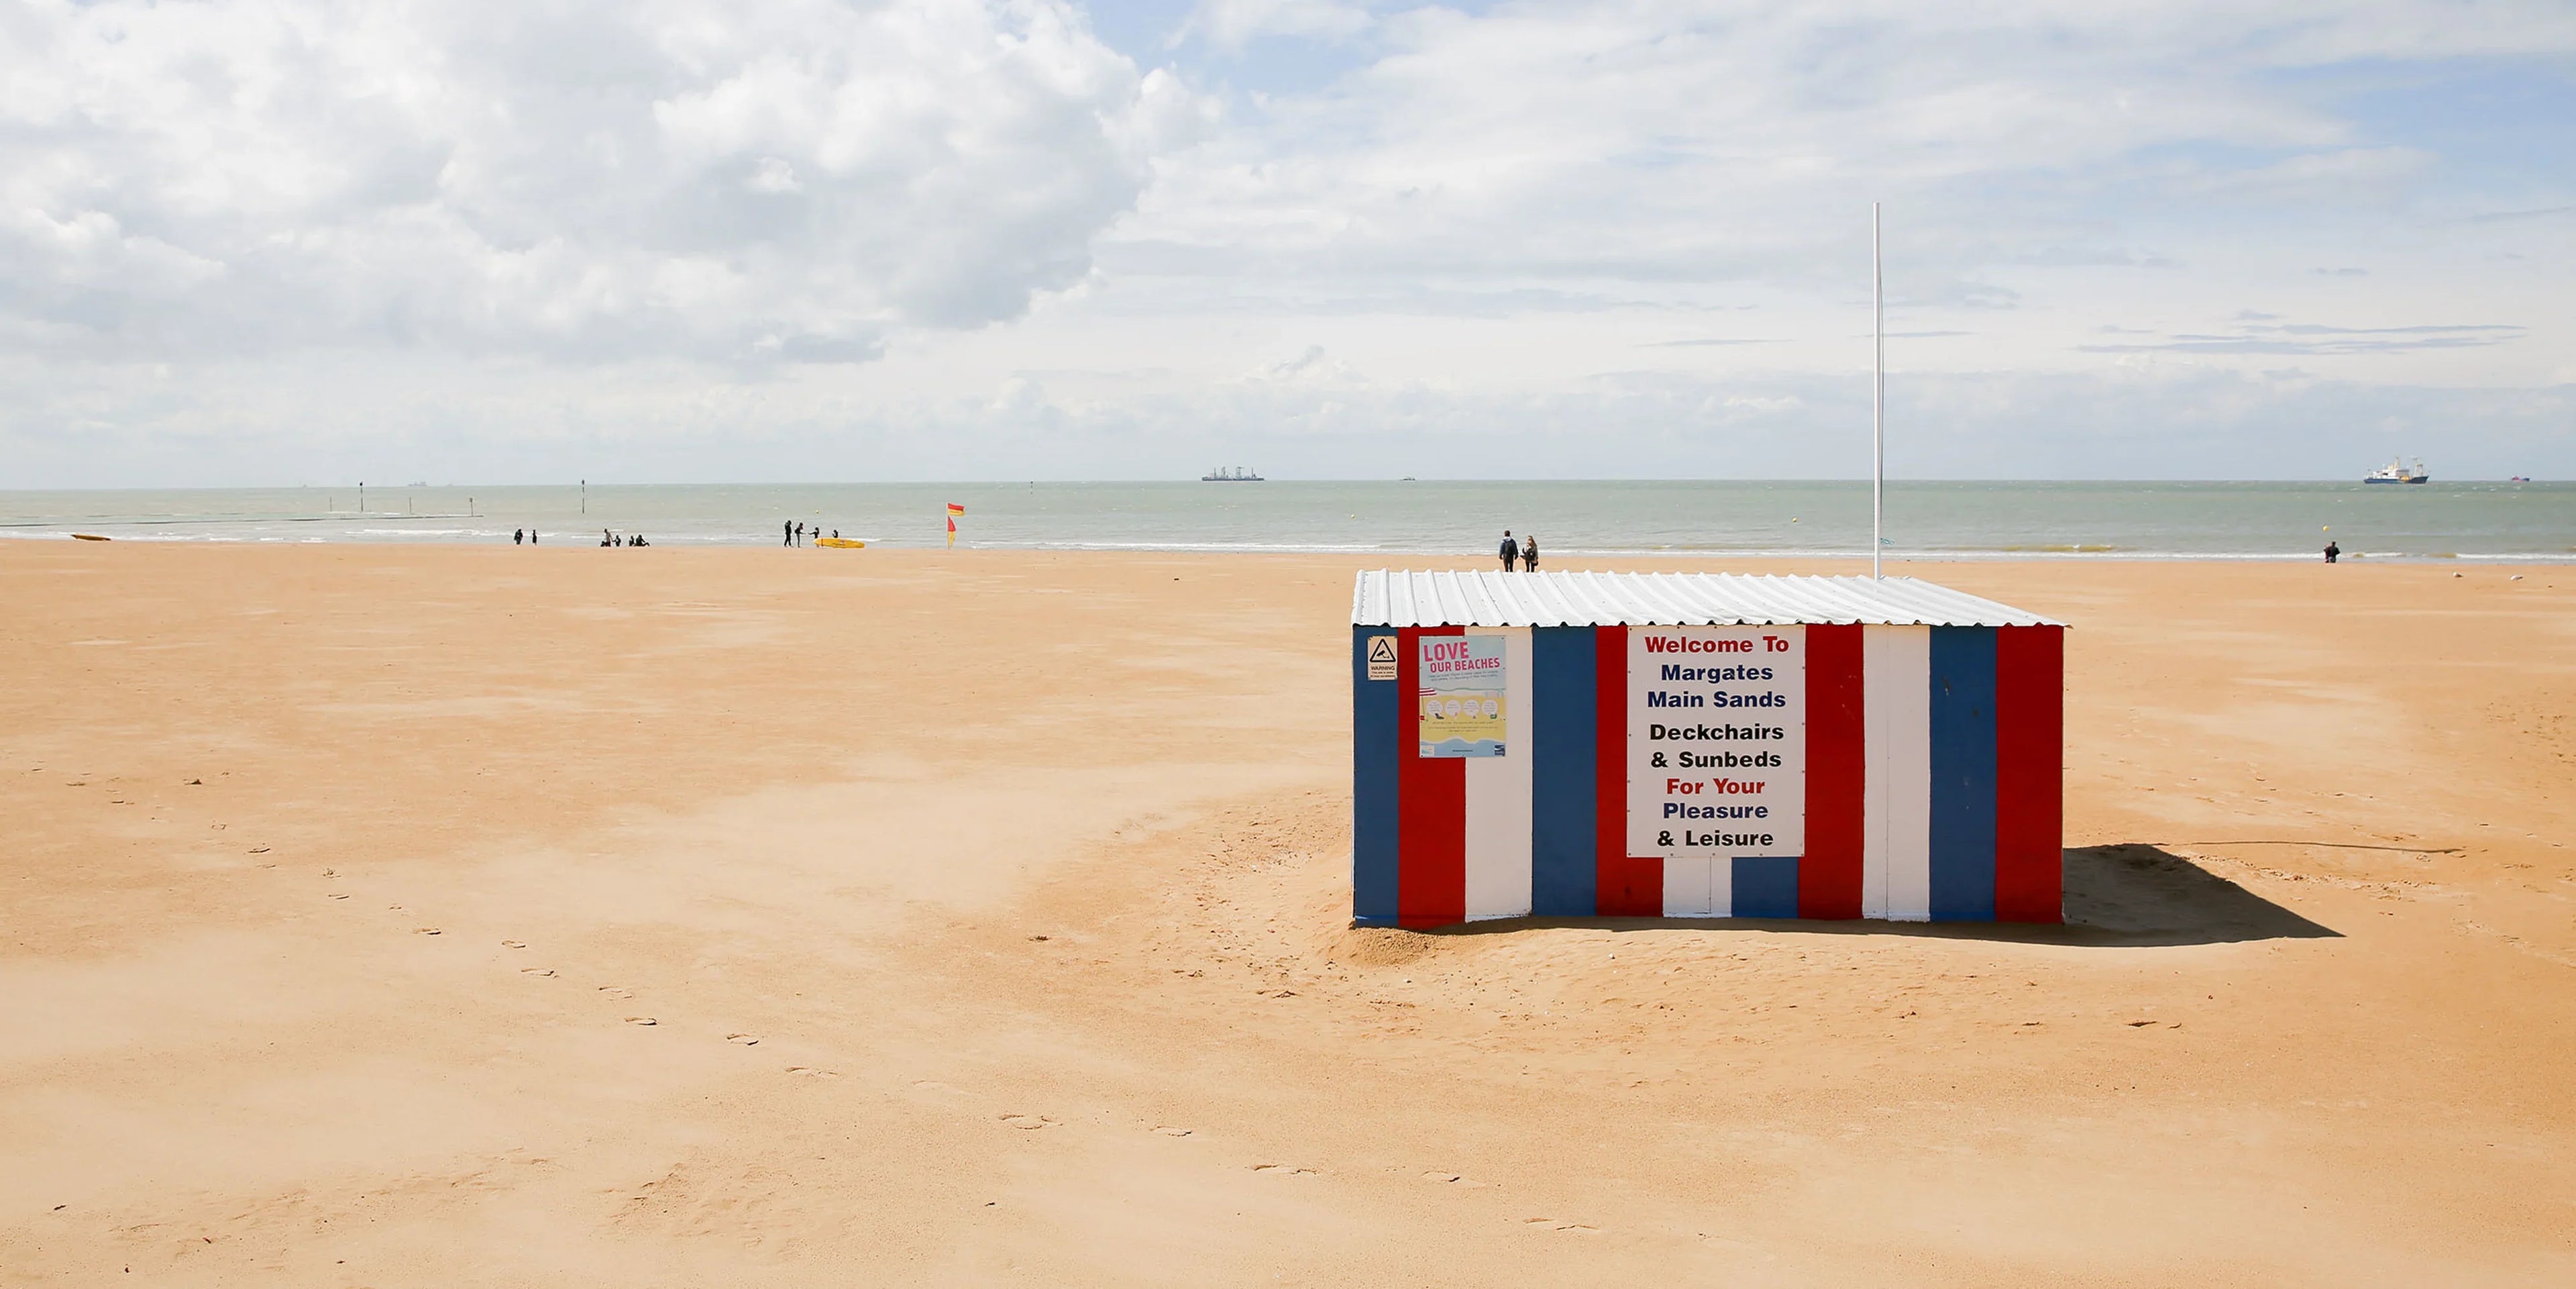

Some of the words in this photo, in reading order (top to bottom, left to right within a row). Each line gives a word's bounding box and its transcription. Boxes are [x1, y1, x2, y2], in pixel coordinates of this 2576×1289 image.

[1424, 641, 1469, 662] LOVE
[1645, 636, 1753, 653] Welcome
[1763, 635, 1789, 653] To
[1430, 662, 1452, 673] OUR
[1454, 658, 1501, 671] BEACHES
[1661, 664, 1773, 684] Margates
[1648, 690, 1704, 708] Main
[1713, 690, 1786, 708] Sands
[1650, 723, 1784, 741] Deckchairs
[1650, 752, 1668, 768] &
[1678, 750, 1782, 768] Sunbeds
[1666, 778, 1704, 794] For
[1713, 778, 1766, 794] Your
[1663, 803, 1768, 819] Pleasure
[1657, 830, 1675, 847] &
[1685, 829, 1774, 847] Leisure
